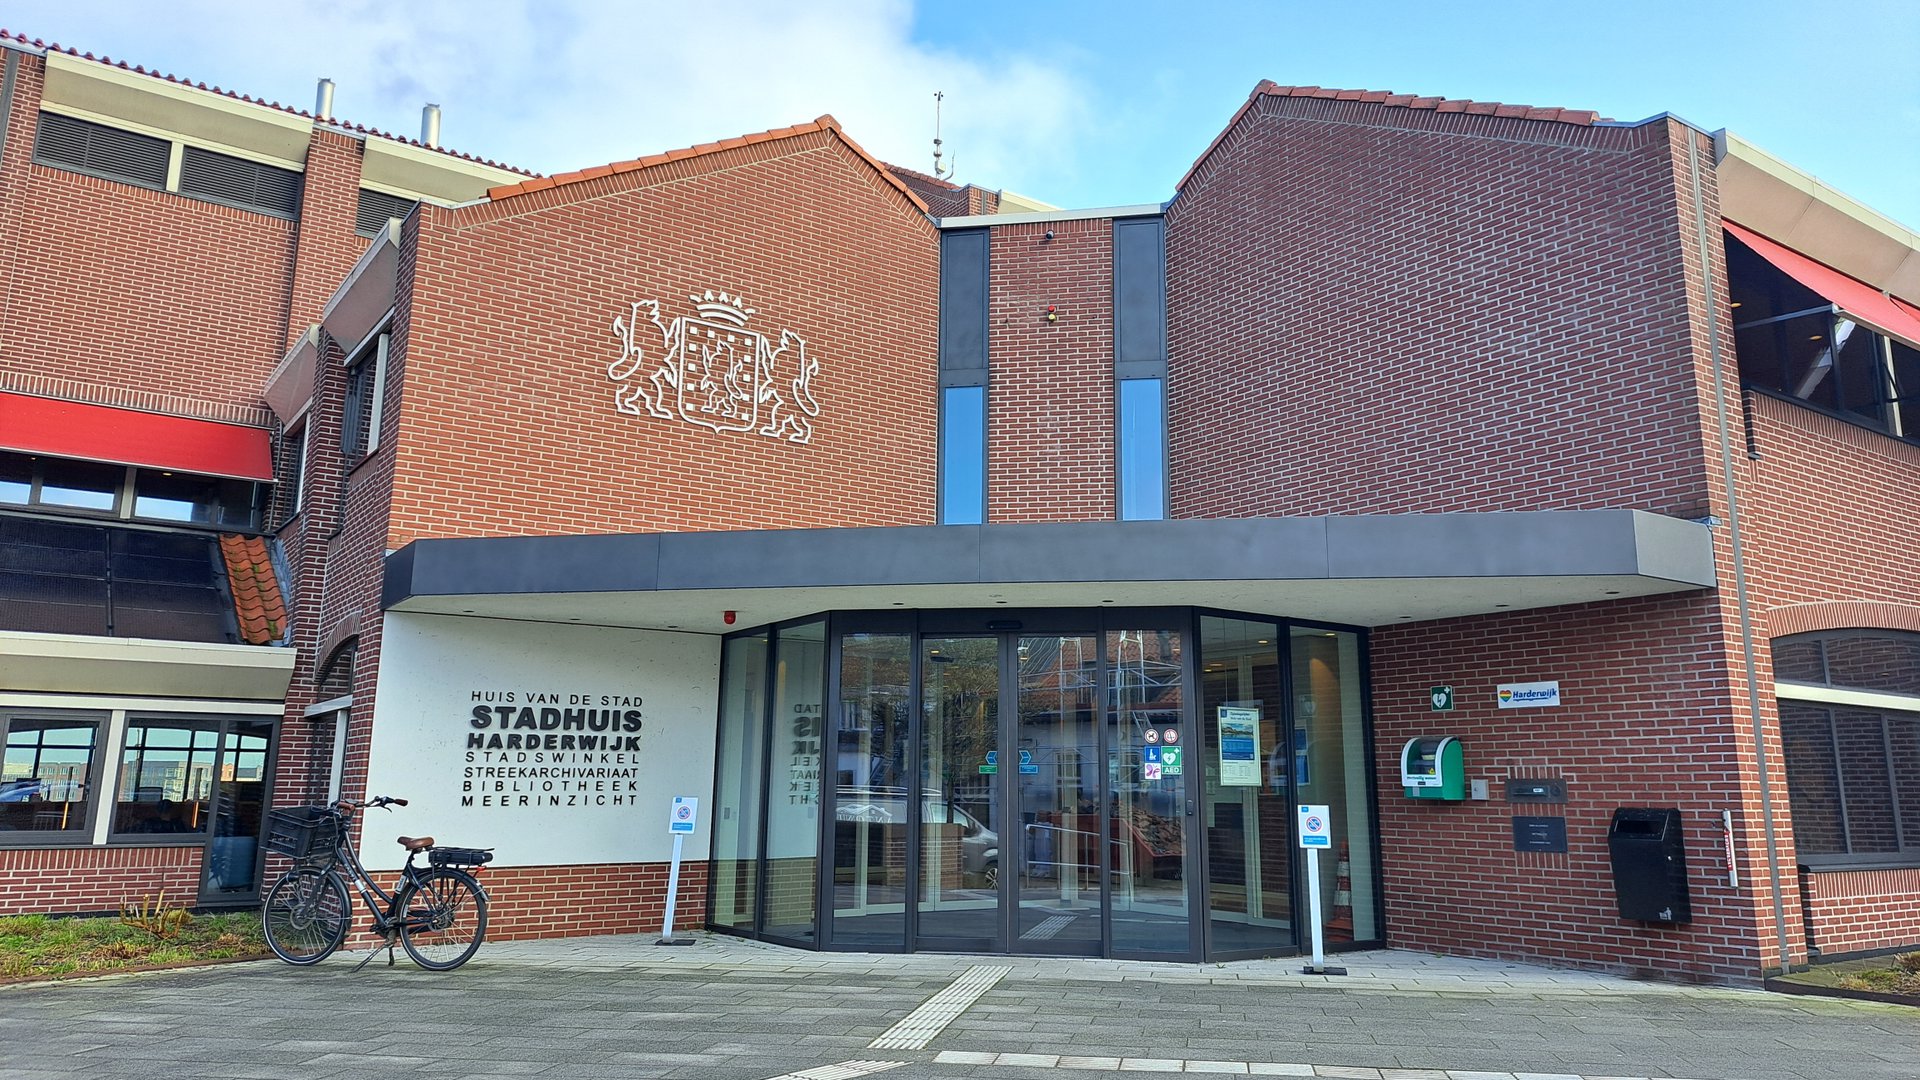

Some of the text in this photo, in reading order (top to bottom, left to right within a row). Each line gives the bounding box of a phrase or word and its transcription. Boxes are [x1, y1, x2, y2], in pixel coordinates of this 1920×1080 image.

[471, 690, 643, 708] HUIS VAN DE STAD
[1512, 688, 1557, 698] Harderwijk
[470, 704, 643, 733] STADHUIS
[466, 732, 642, 753] HARDERWIJK
[465, 751, 640, 765] STADSWINKEL
[463, 766, 639, 779] STREEKARCHIVARIAAT
[462, 780, 638, 792] BIBLIOTHEEK
[461, 794, 637, 807] MEERINZICHT
